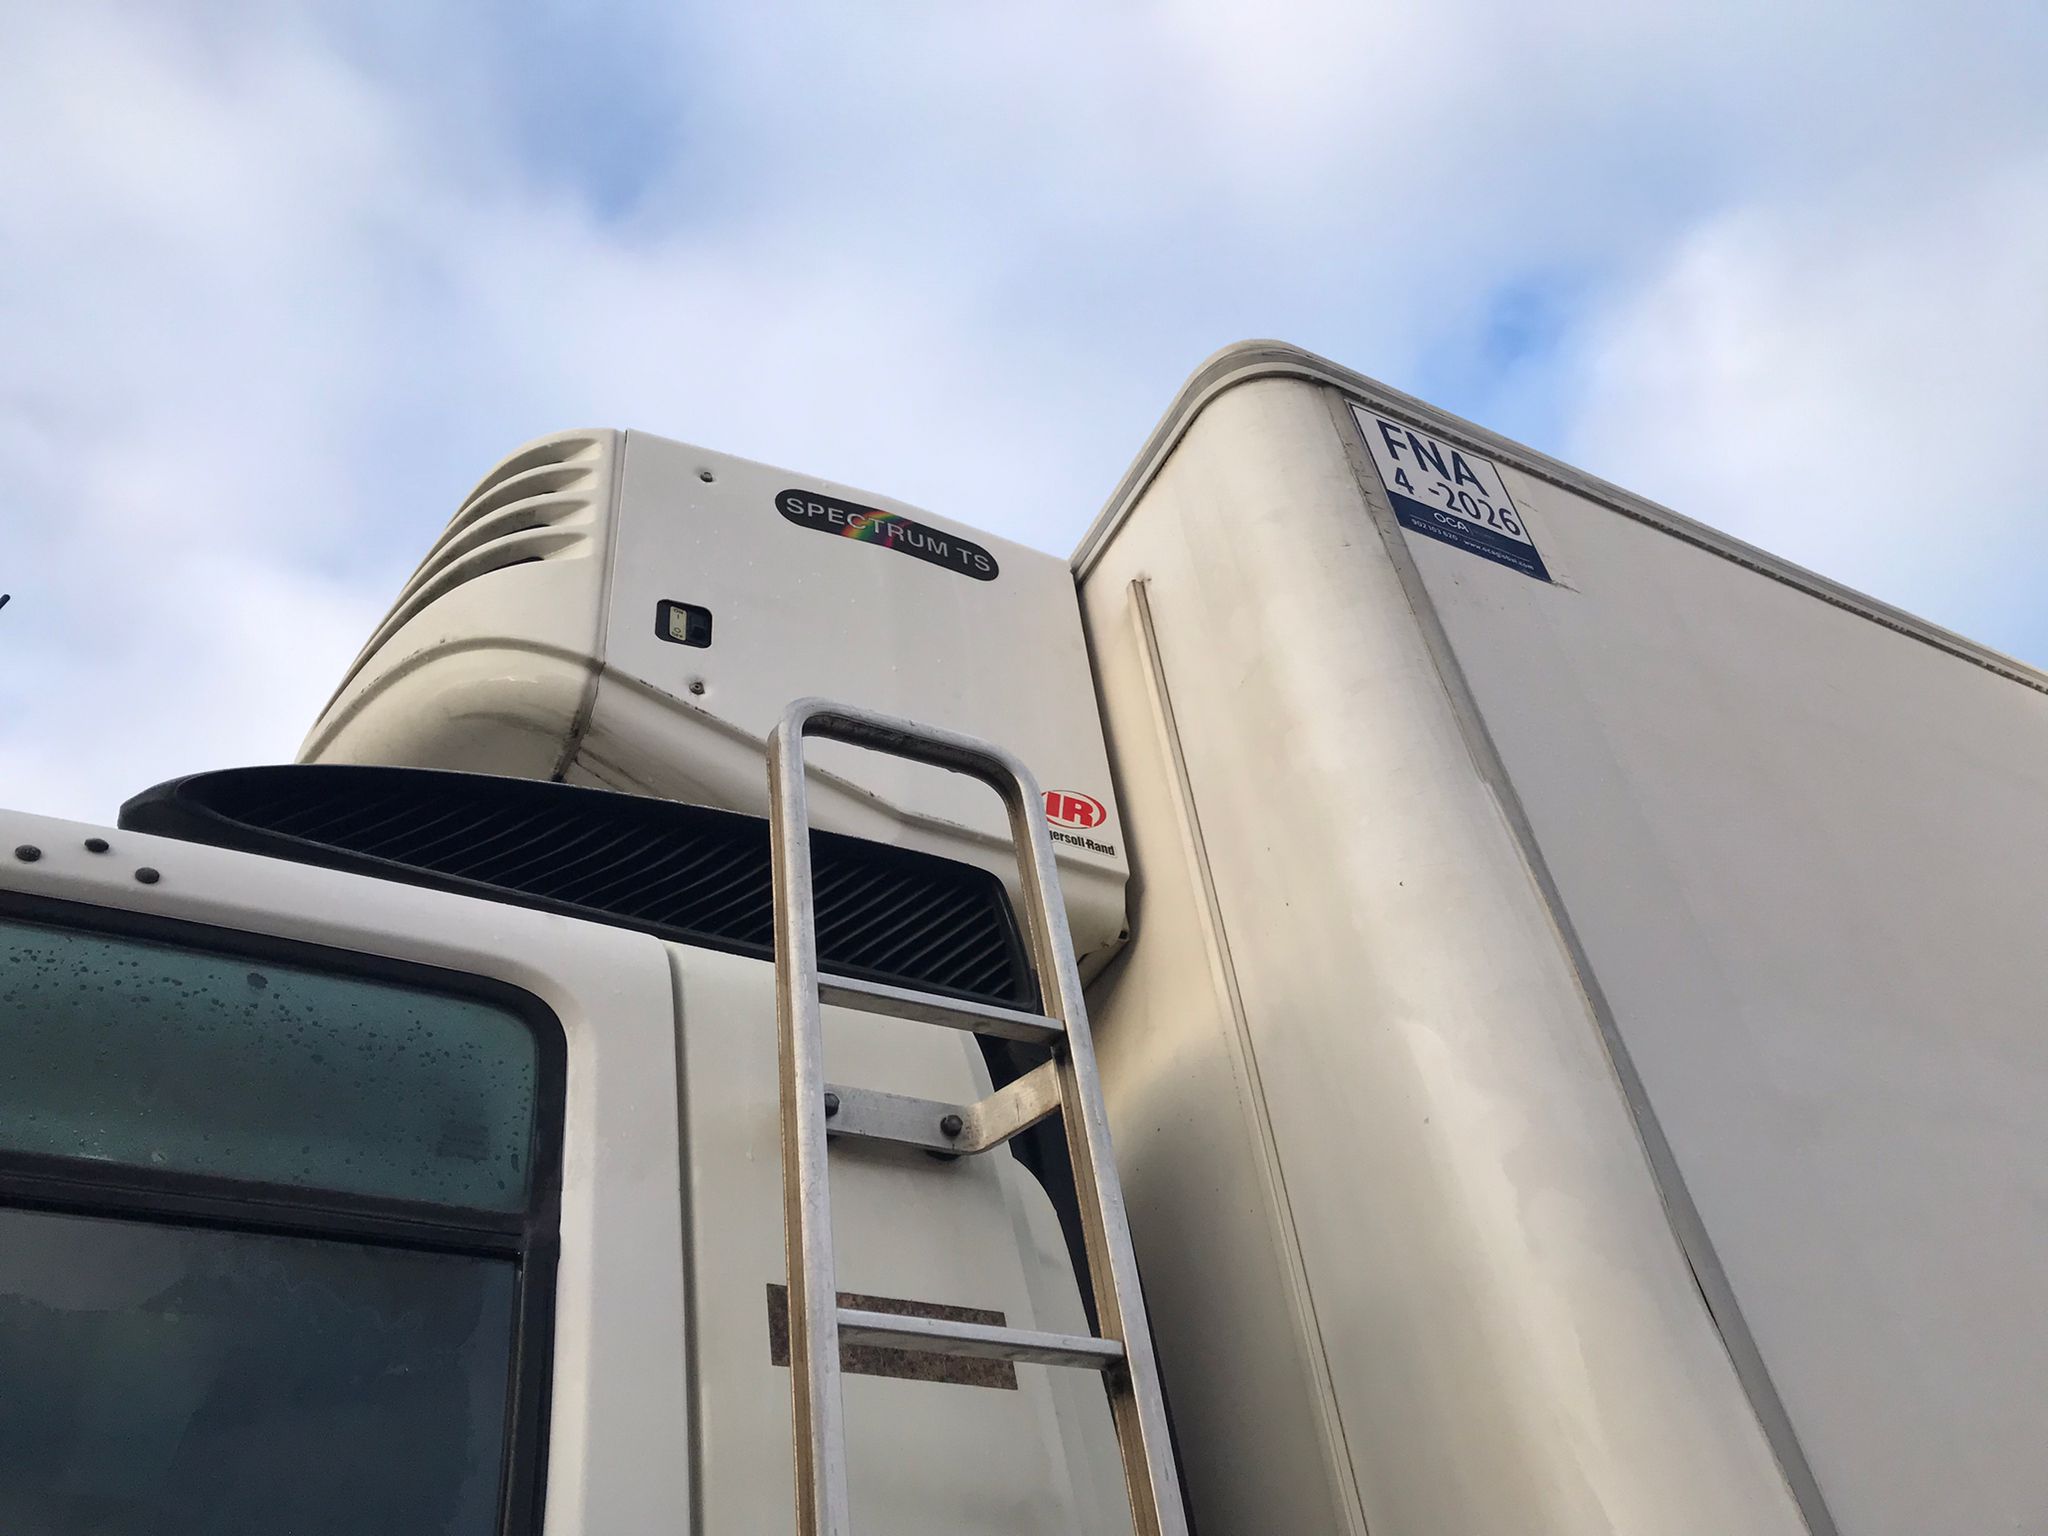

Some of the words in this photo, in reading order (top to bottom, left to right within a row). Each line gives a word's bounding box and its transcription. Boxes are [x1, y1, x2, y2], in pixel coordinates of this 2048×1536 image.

[1376, 419, 1489, 497] FNA
[1394, 467, 1415, 496] 4
[786, 497, 949, 558] SPECTRUM
[956, 547, 991, 572] TS
[1433, 512, 1470, 533] OCA
[1046, 791, 1094, 828] IR
